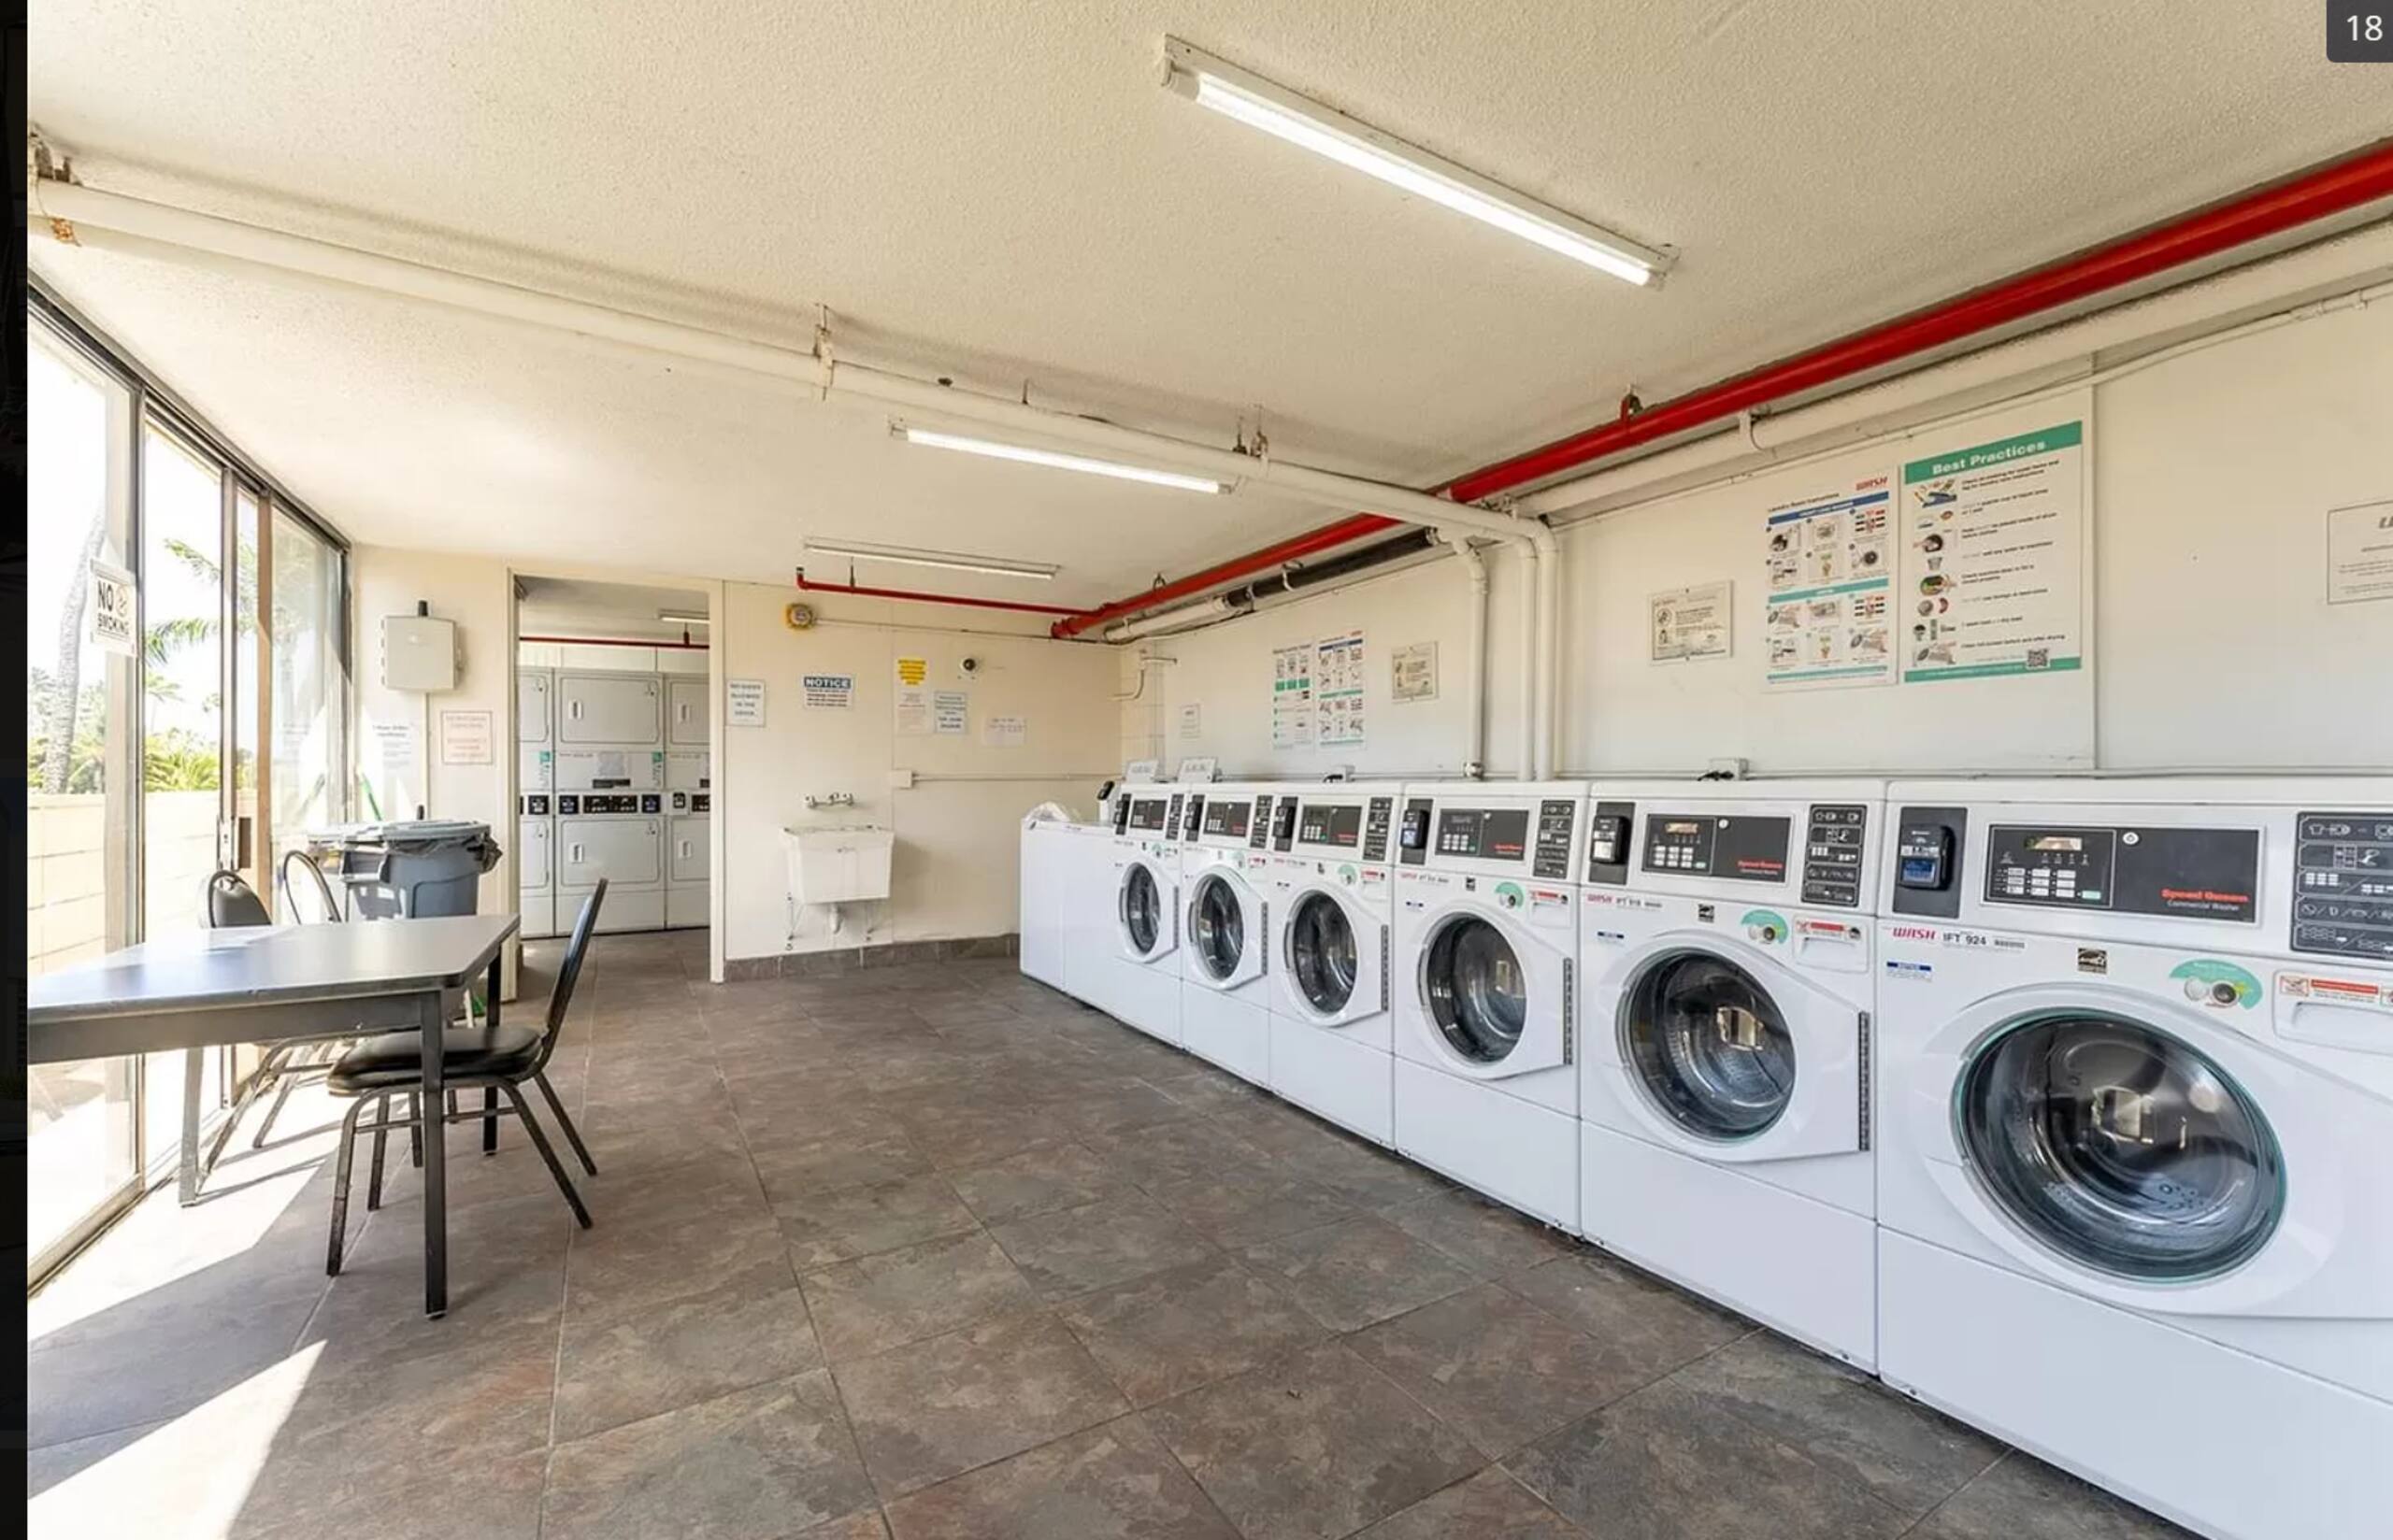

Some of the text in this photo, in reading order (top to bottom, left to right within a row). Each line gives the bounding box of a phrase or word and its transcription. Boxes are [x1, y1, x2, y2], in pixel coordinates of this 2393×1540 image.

[1932, 458, 1966, 476] Best
[1970, 441, 2047, 466] Practices
[97, 579, 114, 612] NO
[97, 612, 130, 635] SMOKING
[806, 678, 849, 688] NOTICE
[1892, 927, 1987, 947] WASH IFT 924
